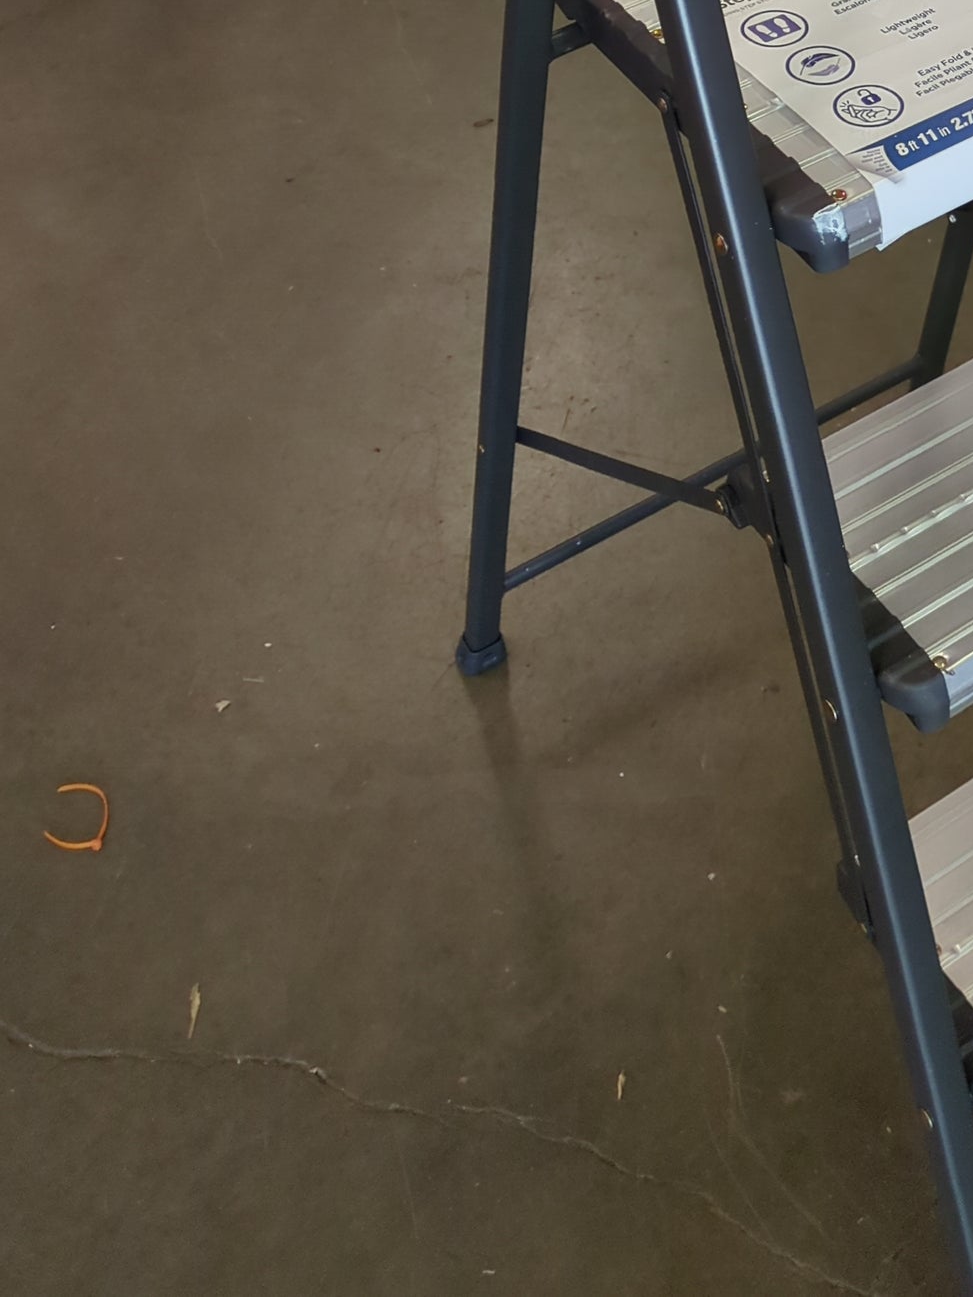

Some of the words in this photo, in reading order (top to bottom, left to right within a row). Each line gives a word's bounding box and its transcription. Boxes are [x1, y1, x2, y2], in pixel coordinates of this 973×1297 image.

[880, 8, 936, 34] Lightweight
[908, 25, 939, 40] Ligero
[914, 72, 944, 88] Facile
[943, 60, 972, 75] Pliant
[917, 63, 941, 77] Easy
[940, 52, 964, 67] Fold
[915, 84, 941, 97] Facil
[895, 142, 909, 156] 8
[908, 140, 920, 152] ft
[917, 128, 938, 145] 11
[937, 126, 951, 138] in
